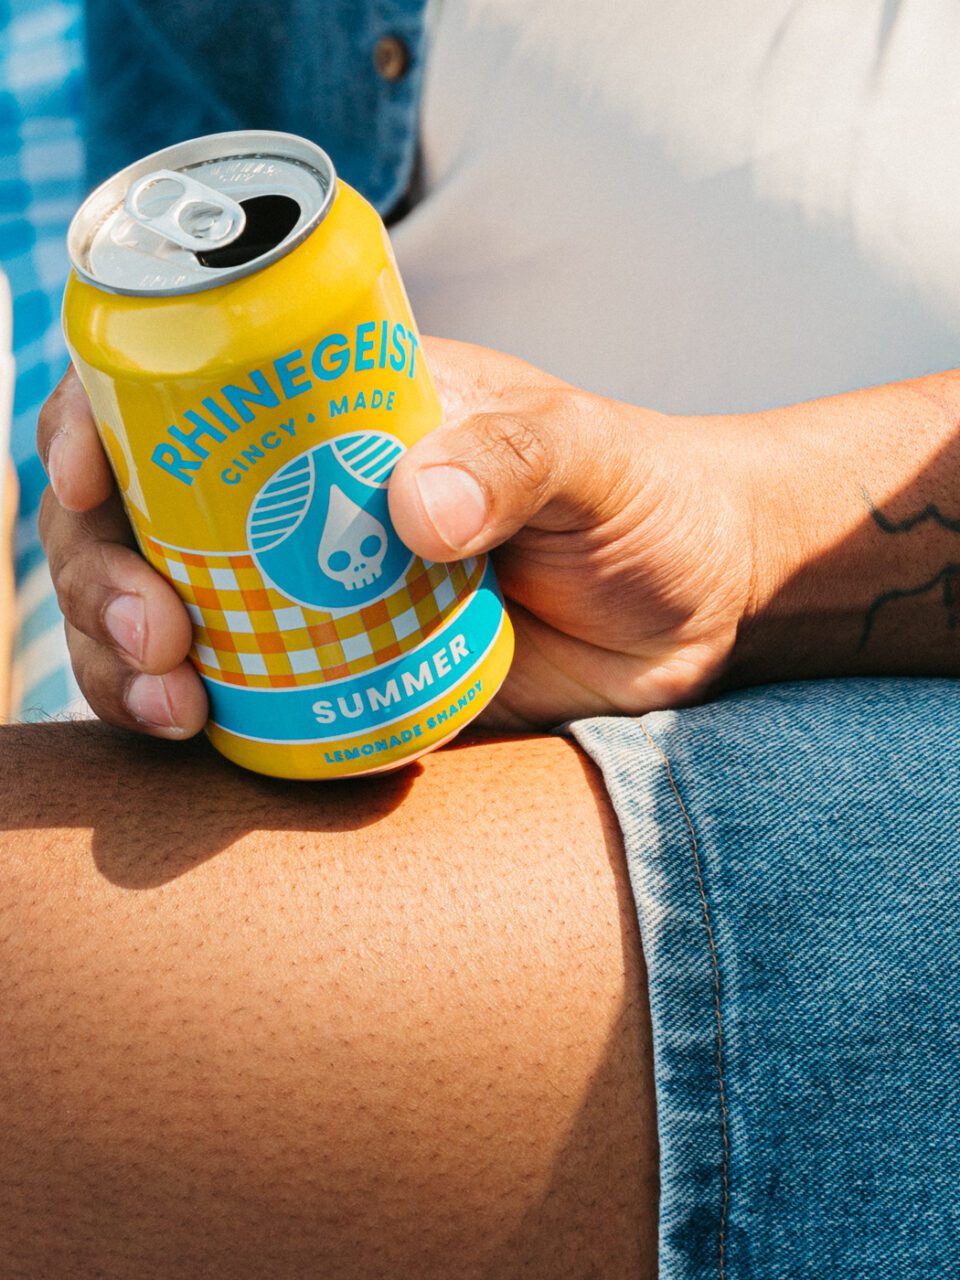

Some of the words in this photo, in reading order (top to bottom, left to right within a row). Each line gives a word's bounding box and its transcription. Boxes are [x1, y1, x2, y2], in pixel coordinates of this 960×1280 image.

[150, 320, 419, 487] RHINEGEIST
[220, 418, 297, 486] CINCY
[328, 389, 396, 418] MADE
[312, 633, 470, 724] SUMMER
[324, 724, 424, 764] LEMONADE
[425, 679, 483, 730] SHANDY
